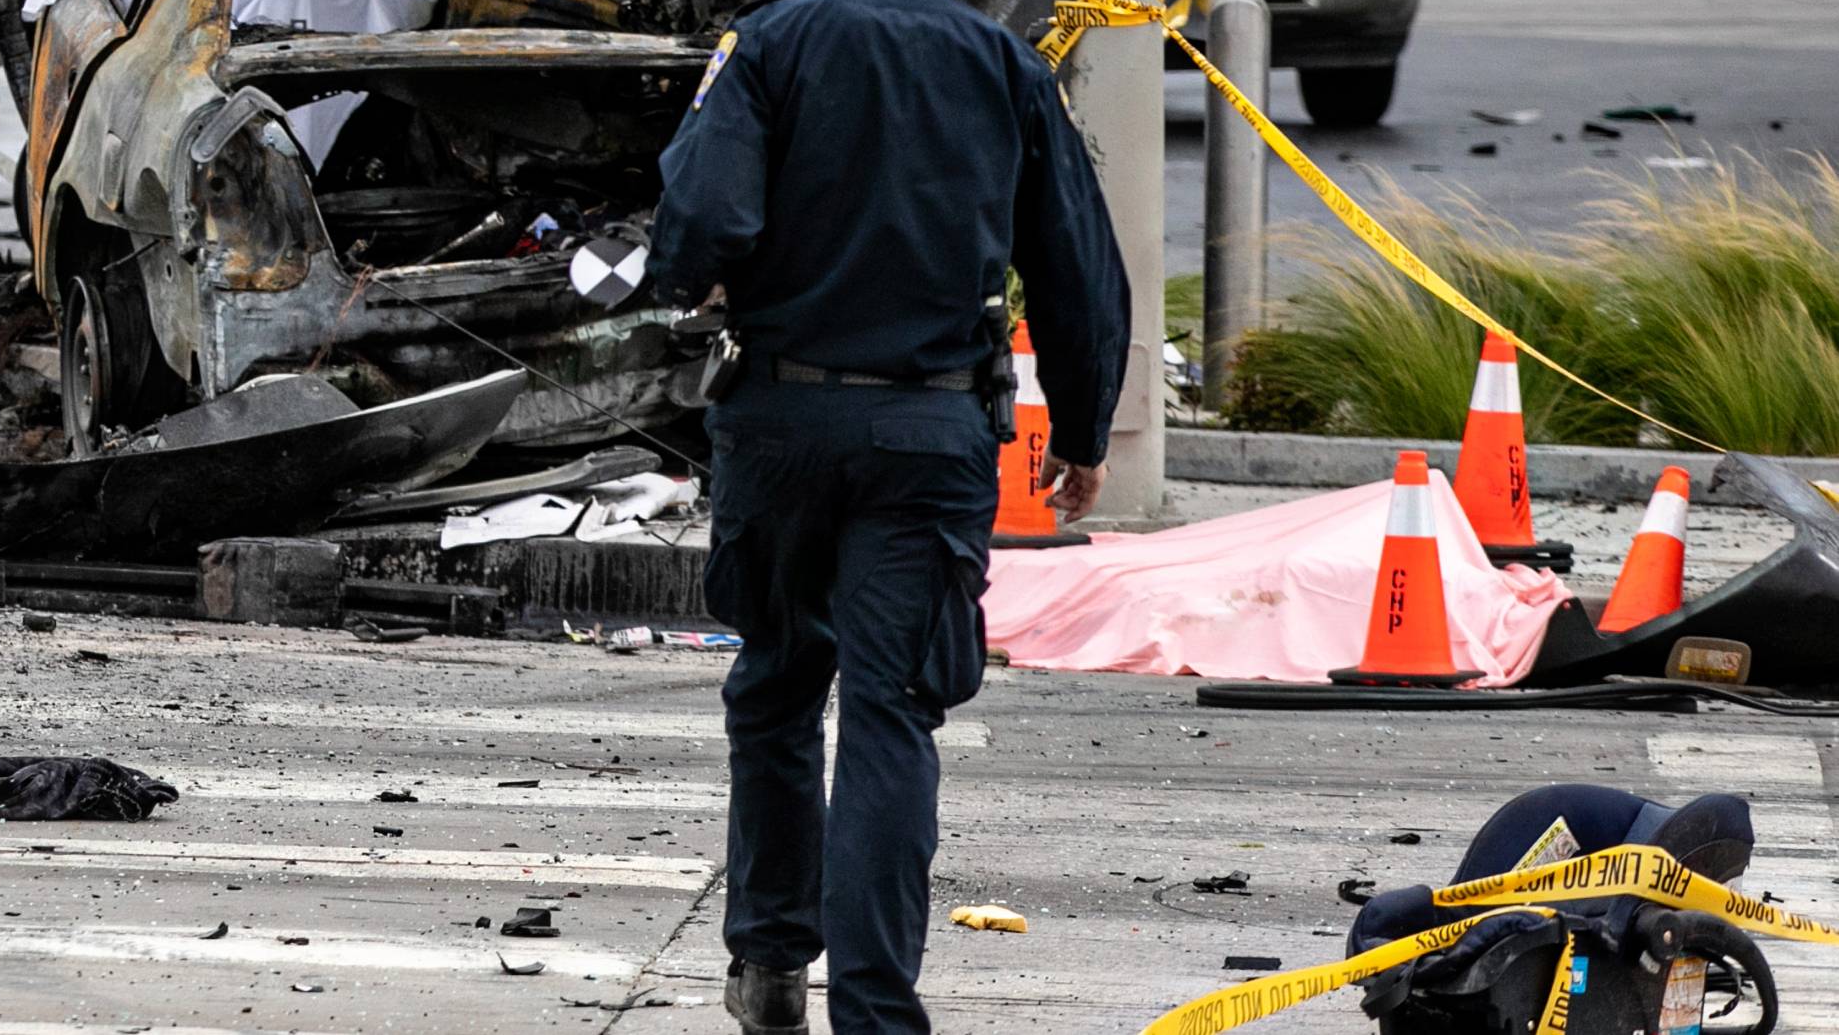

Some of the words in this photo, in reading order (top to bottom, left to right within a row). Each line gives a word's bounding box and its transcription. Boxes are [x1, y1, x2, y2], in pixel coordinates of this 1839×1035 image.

[1056, 6, 1109, 28] CROSS
[1389, 569, 1408, 635] CHP
[1562, 855, 1592, 890] DO
[1597, 851, 1642, 887] LINE
[1649, 854, 1693, 898] FIRE
